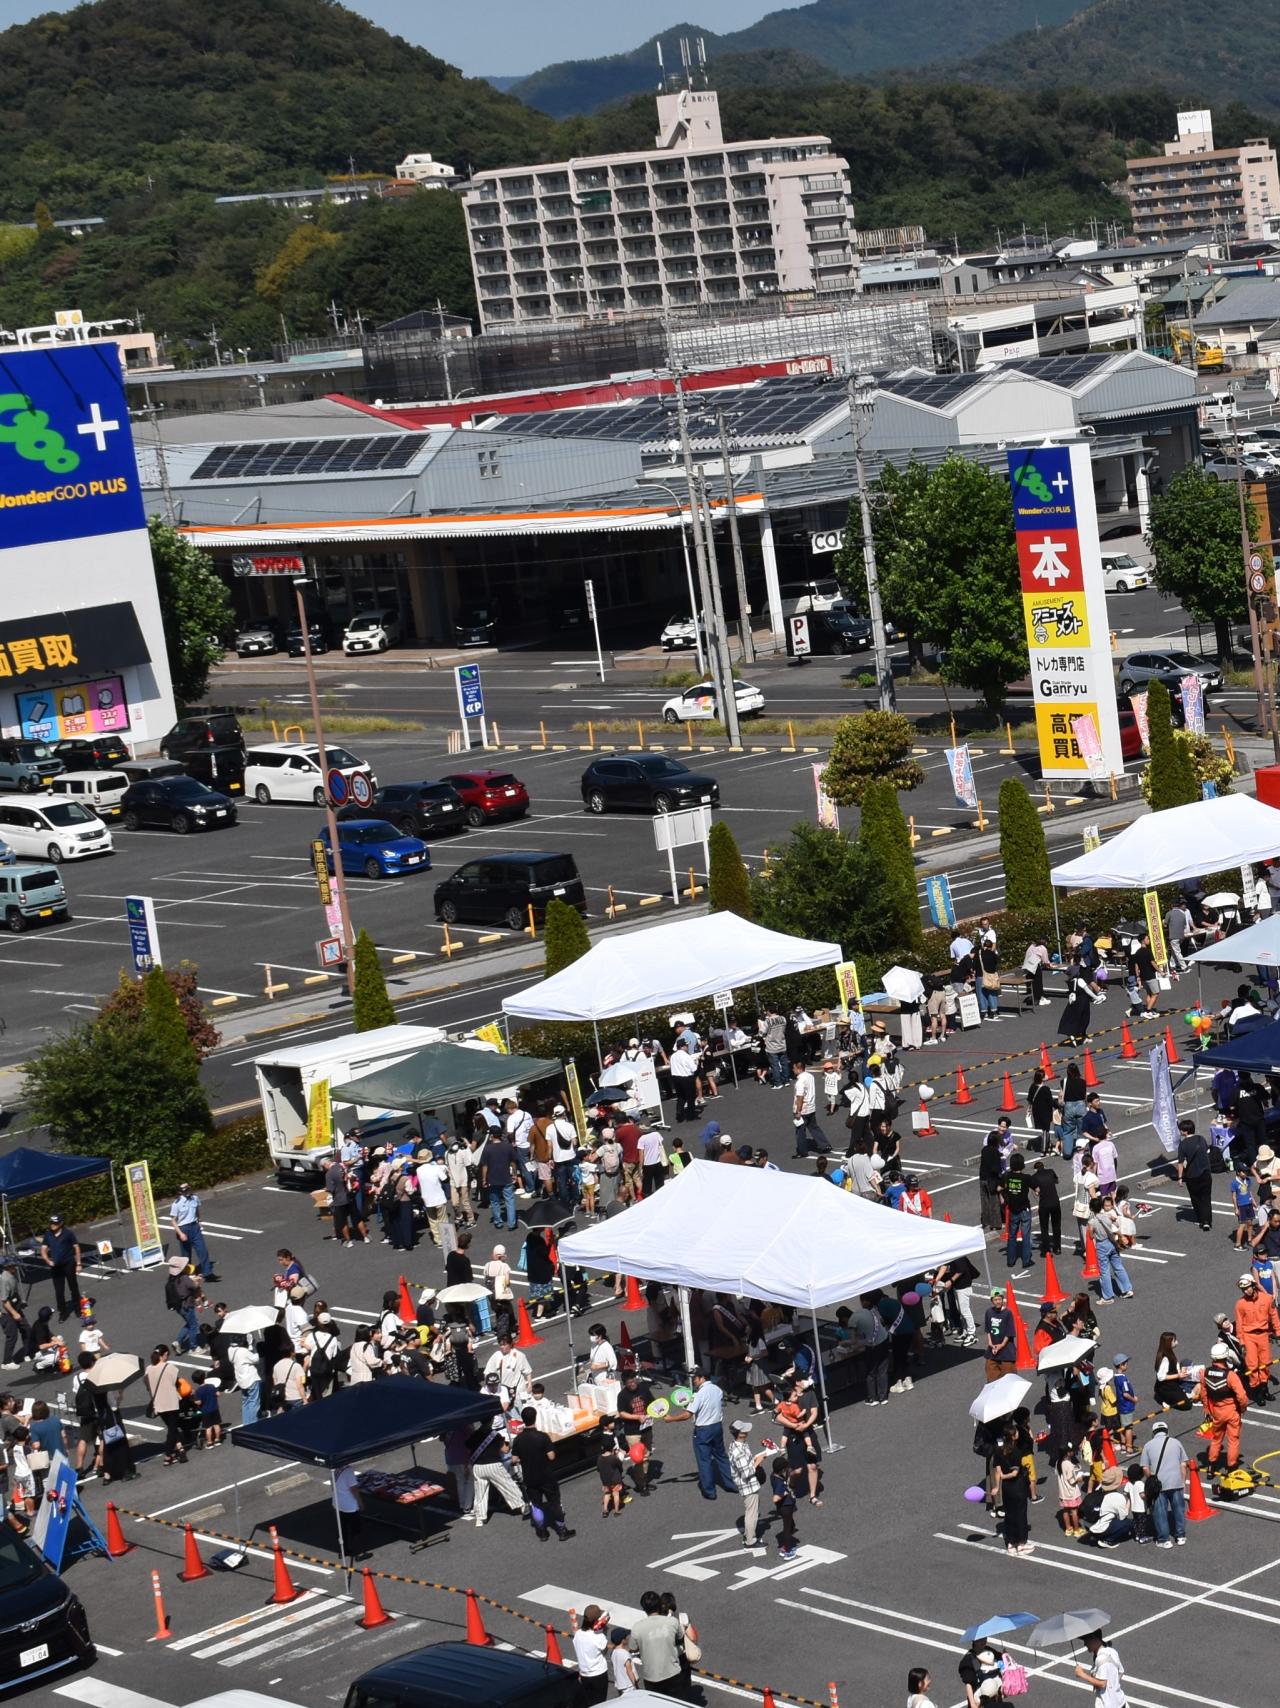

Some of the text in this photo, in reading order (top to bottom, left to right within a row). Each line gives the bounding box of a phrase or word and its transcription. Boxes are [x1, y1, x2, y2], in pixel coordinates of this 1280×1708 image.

[90, 477, 128, 496] PLUS
[1055, 506, 1071, 514] PLUS
[1029, 536, 1070, 586] 本
[1032, 597, 1064, 607] AMUSEMENT
[1032, 602, 1074, 627] アミューズ
[793, 619, 804, 635] P
[1056, 617, 1084, 638] メント
[1036, 656, 1085, 672] トレカ専門店
[1040, 679, 1087, 697] Ganryu
[355, 777, 368, 796] 50
